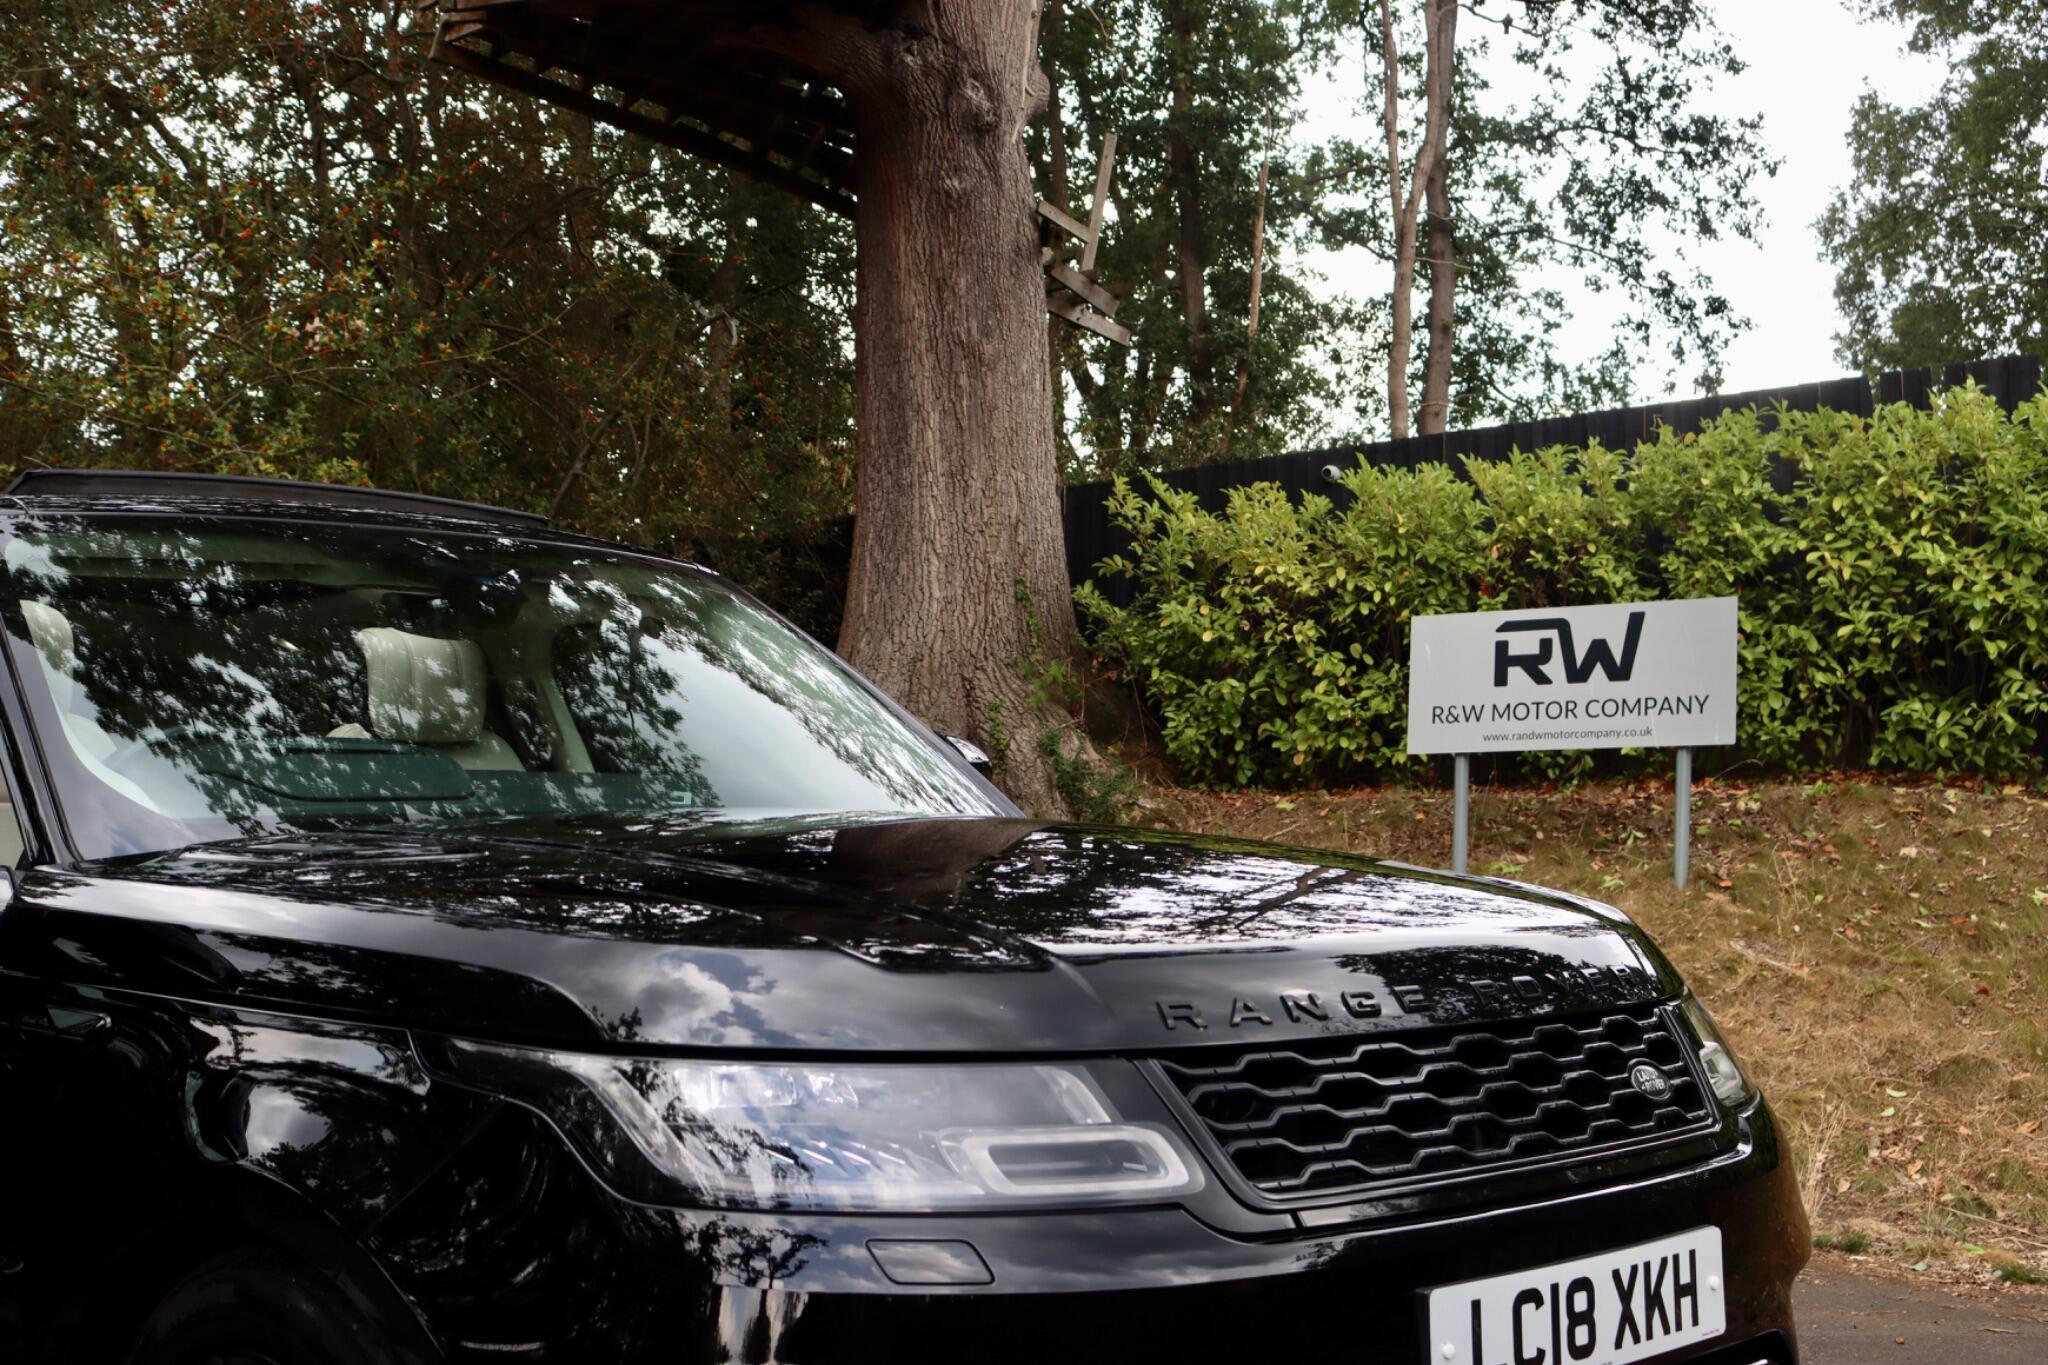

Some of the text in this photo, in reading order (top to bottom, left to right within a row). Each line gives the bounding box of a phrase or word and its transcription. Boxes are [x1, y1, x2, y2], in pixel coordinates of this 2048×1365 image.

[1494, 611, 1645, 687] RW
[1431, 694, 1710, 724] R&W MOTOR COMPANY
[1482, 726, 1653, 743] www.randwmotorcompany.co.uk
[1156, 984, 1434, 1030] RANGE
[1471, 1249, 1699, 1365] LC18 XKH
